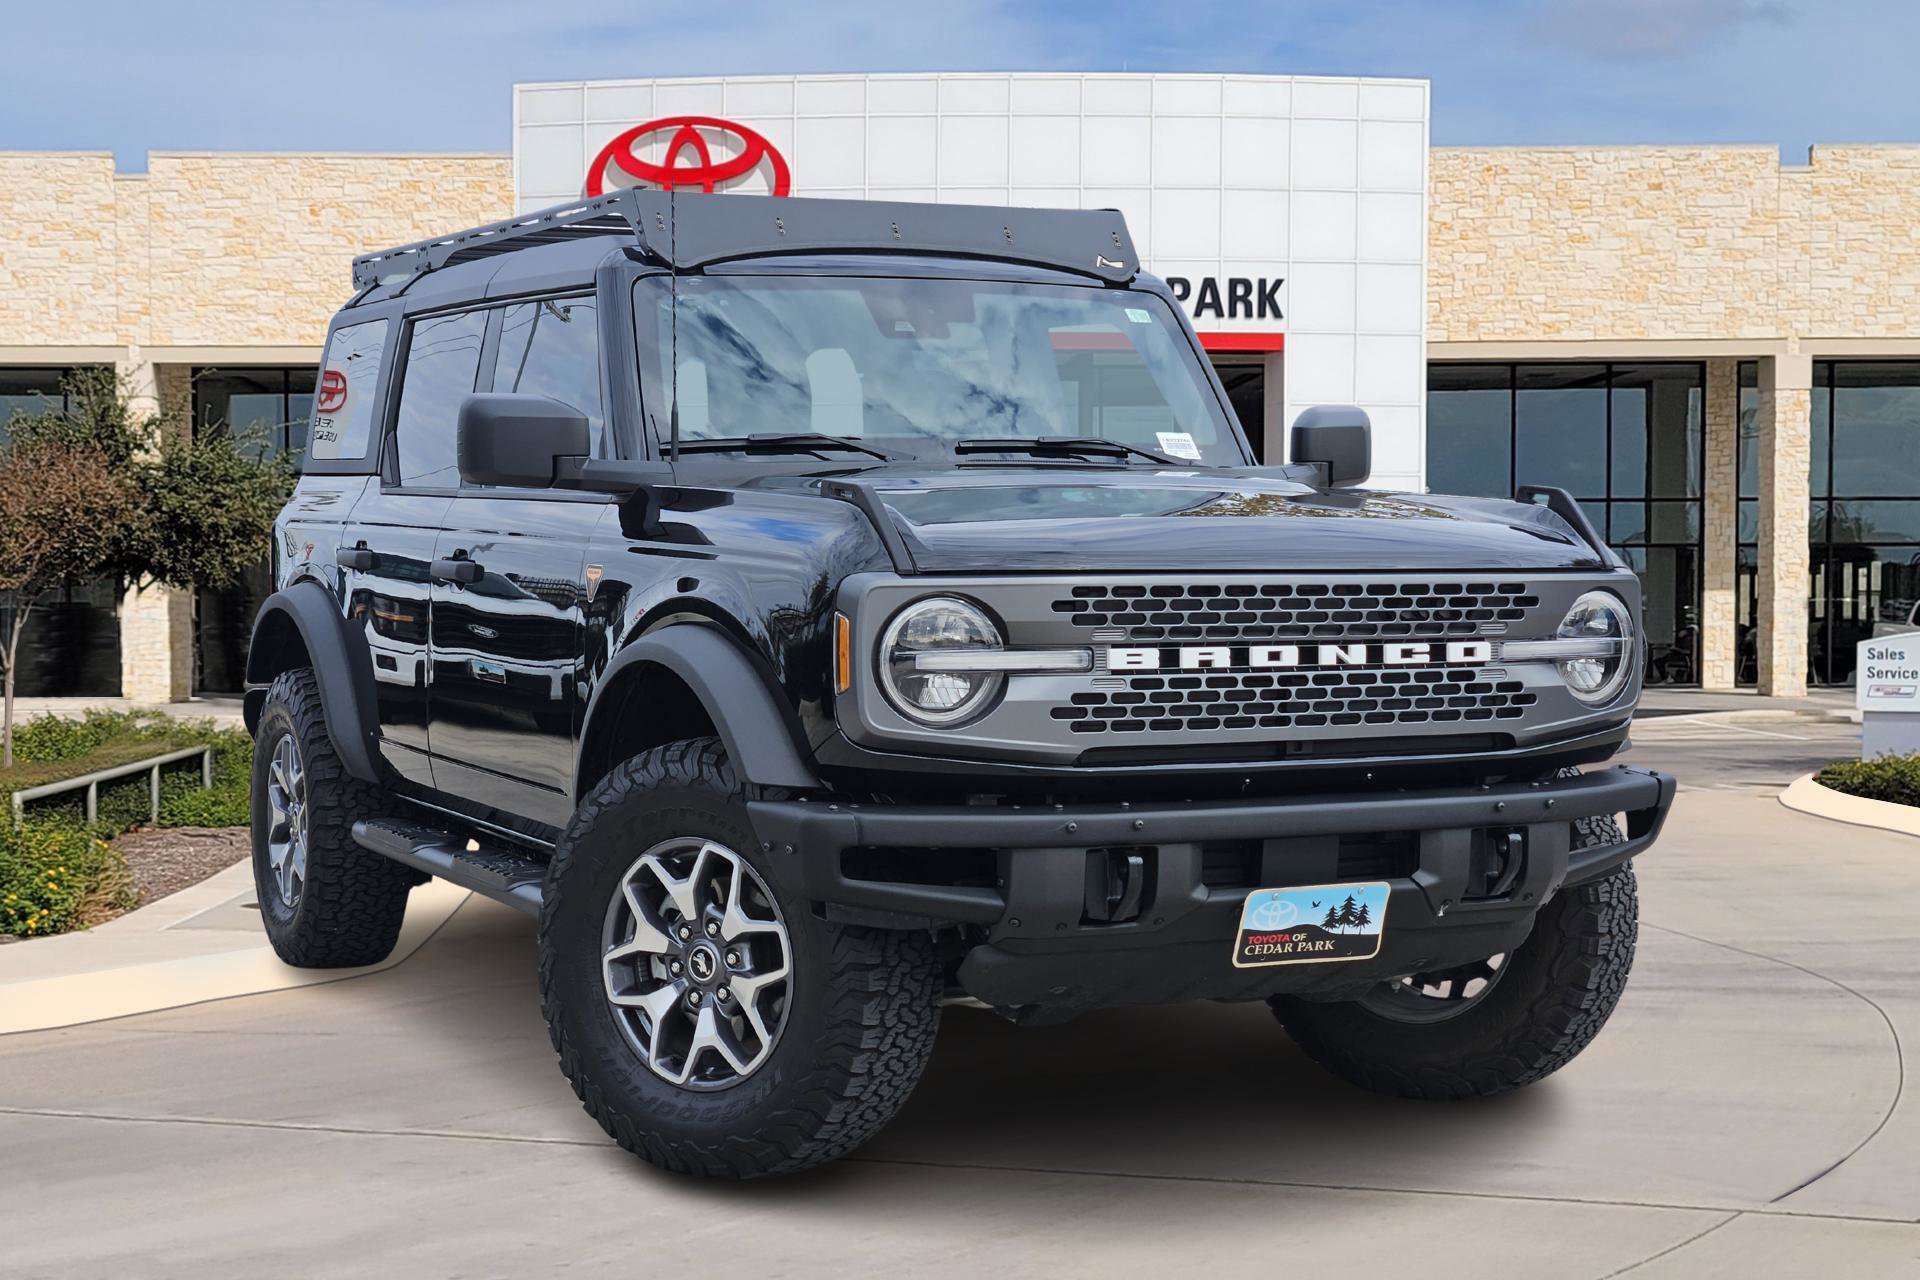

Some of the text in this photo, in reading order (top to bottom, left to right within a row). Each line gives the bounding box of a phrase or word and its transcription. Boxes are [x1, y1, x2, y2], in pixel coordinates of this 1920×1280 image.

[1165, 277, 1285, 319] PARK
[1106, 641, 1492, 670] BRONCO
[1867, 647, 1905, 660] Sales
[1867, 666, 1919, 679] Service
[1247, 933, 1307, 944] TOYOTA OF
[1244, 940, 1335, 955] CEDAR PARK
